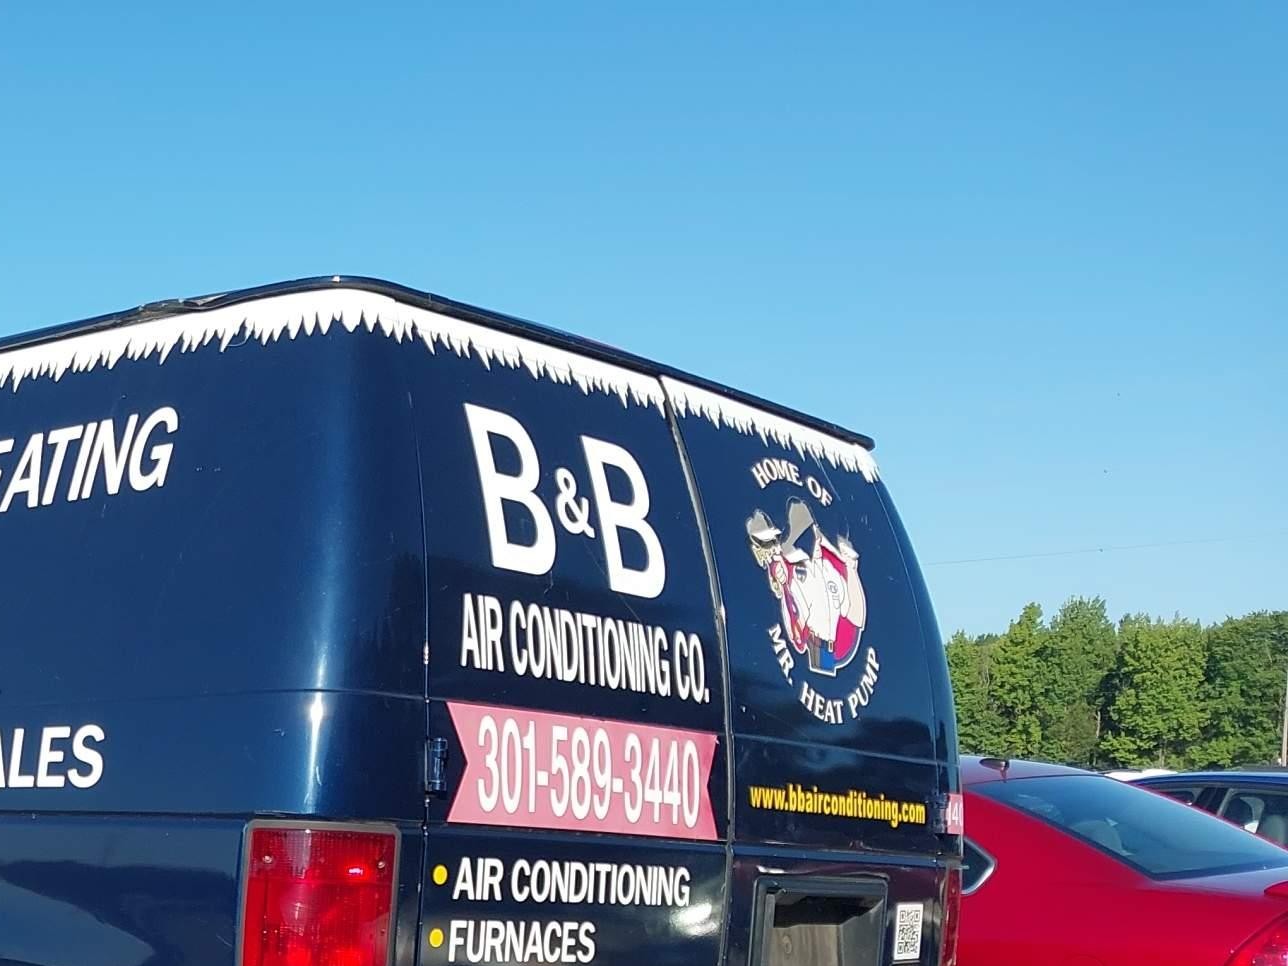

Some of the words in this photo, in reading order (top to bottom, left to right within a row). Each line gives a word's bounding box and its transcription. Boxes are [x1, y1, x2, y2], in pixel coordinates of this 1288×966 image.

[464, 402, 665, 598] B&B
[751, 457, 804, 489] HOME
[806, 476, 833, 507] OF
[461, 593, 505, 672] AIR
[510, 600, 671, 698] CONDITIONING
[674, 630, 710, 703] CO.
[768, 623, 796, 685] MR.
[799, 681, 844, 725] HEAT
[847, 646, 881, 719] PUMP
[477, 714, 700, 829] 301-589-3440
[750, 784, 926, 828] www.bbairconditioning.com
[453, 857, 503, 901] AIR
[511, 858, 691, 908] CONDITIONING
[448, 920, 596, 963] FURNACES
